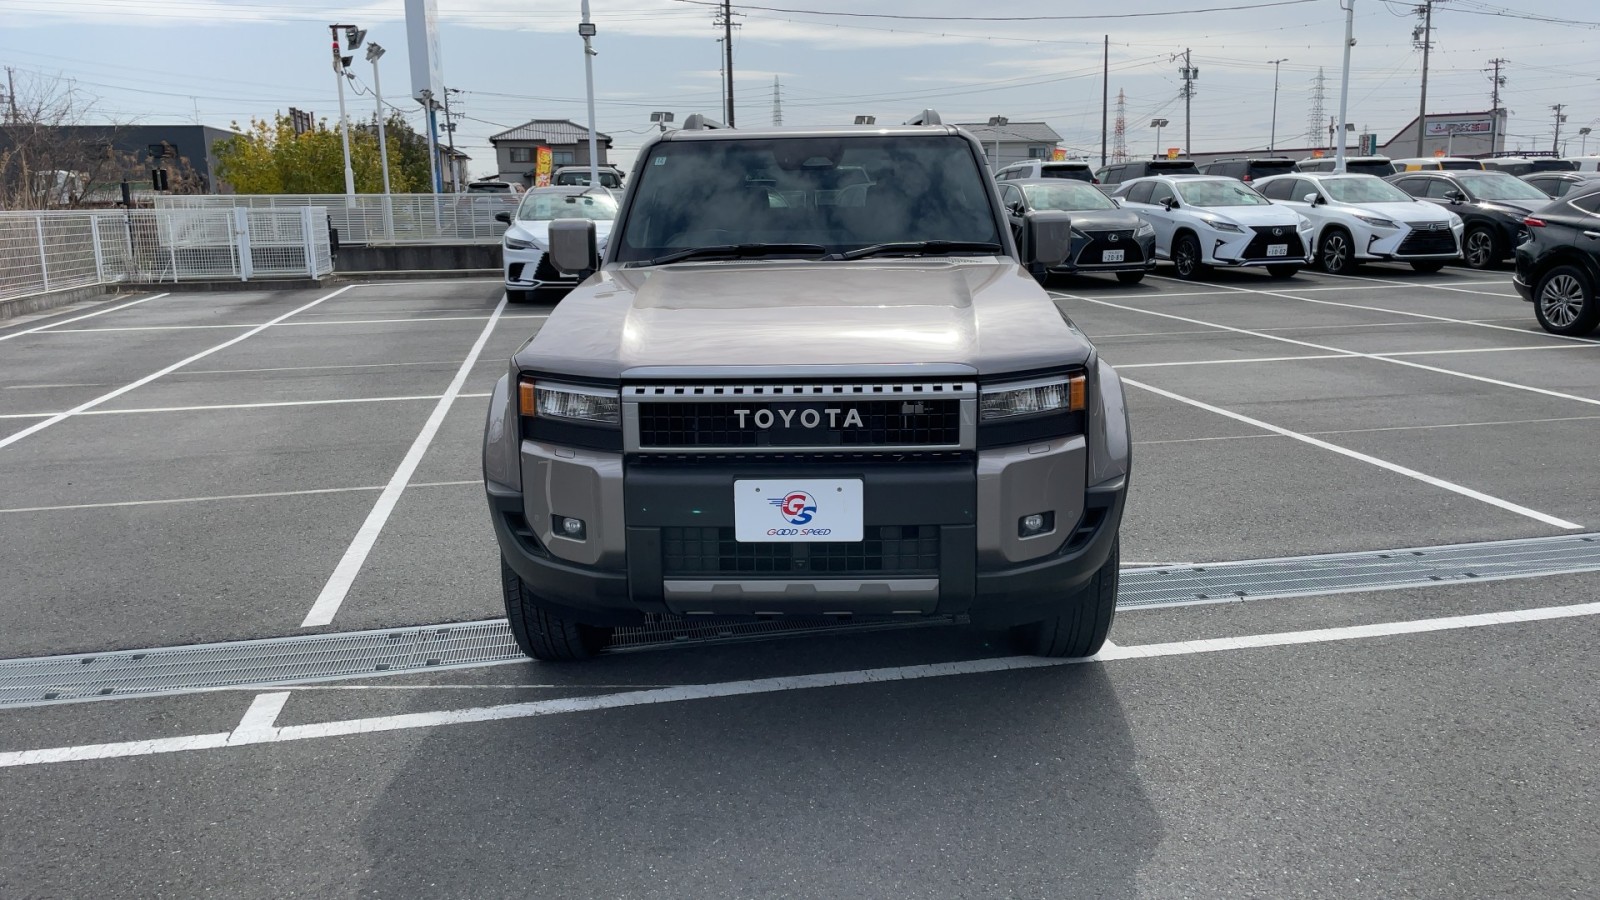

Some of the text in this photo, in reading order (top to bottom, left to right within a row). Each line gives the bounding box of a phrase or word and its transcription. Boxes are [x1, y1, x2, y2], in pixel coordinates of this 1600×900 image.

[733, 408, 864, 429] TOYOTA
[782, 494, 817, 525] GS
[767, 528, 831, 536] GOOD SPEED
